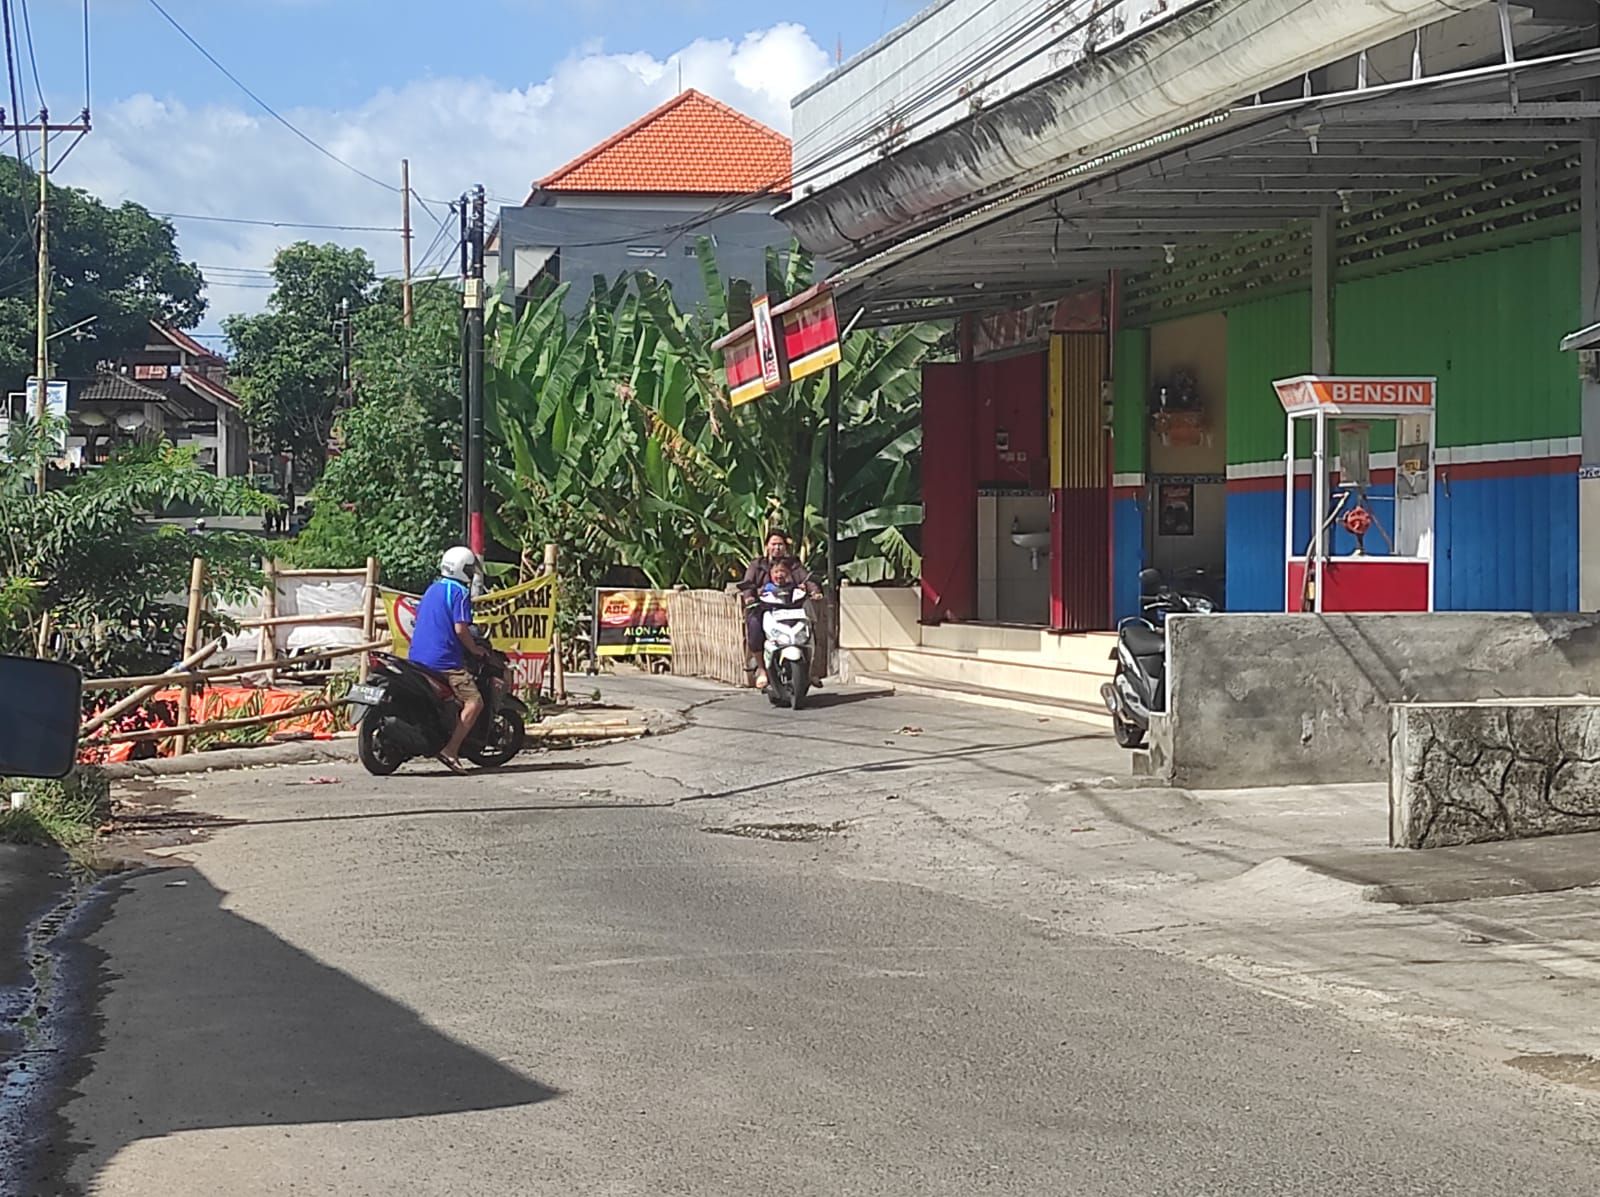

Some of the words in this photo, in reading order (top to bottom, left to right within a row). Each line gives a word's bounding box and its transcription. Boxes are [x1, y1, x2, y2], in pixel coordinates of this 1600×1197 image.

[1332, 382, 1424, 402] BENSIN
[604, 604, 629, 615] ABC
[501, 614, 549, 639] EMPAT
